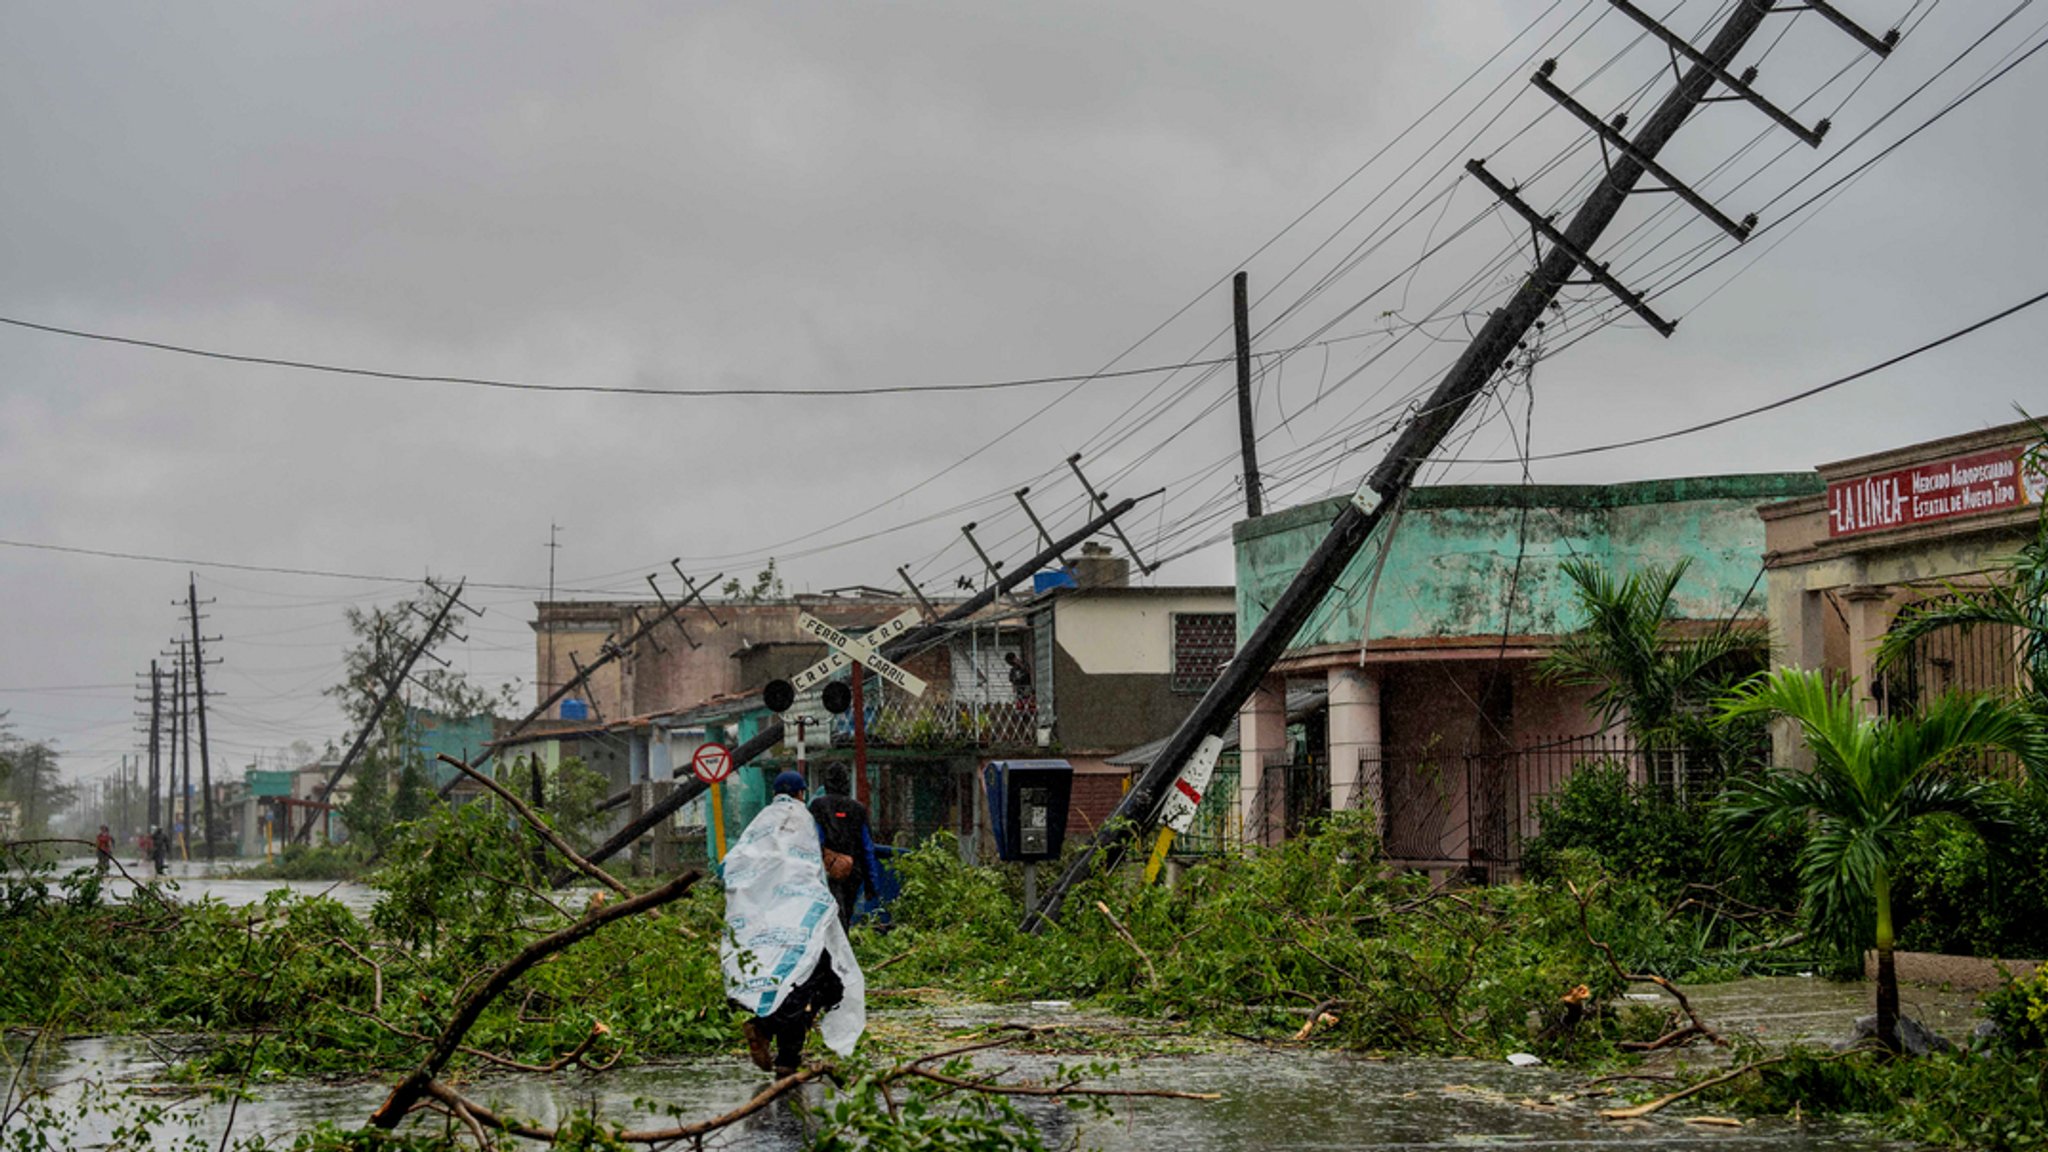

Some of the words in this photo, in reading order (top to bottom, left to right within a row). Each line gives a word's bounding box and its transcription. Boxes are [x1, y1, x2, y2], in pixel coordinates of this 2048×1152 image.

[1830, 488, 1855, 531] LA
[1857, 477, 1908, 527] LÍNEA
[795, 654, 842, 689] CRUC
[868, 620, 903, 646] ERO
[806, 620, 848, 647] FERRO
[867, 655, 905, 685] CARRIL
